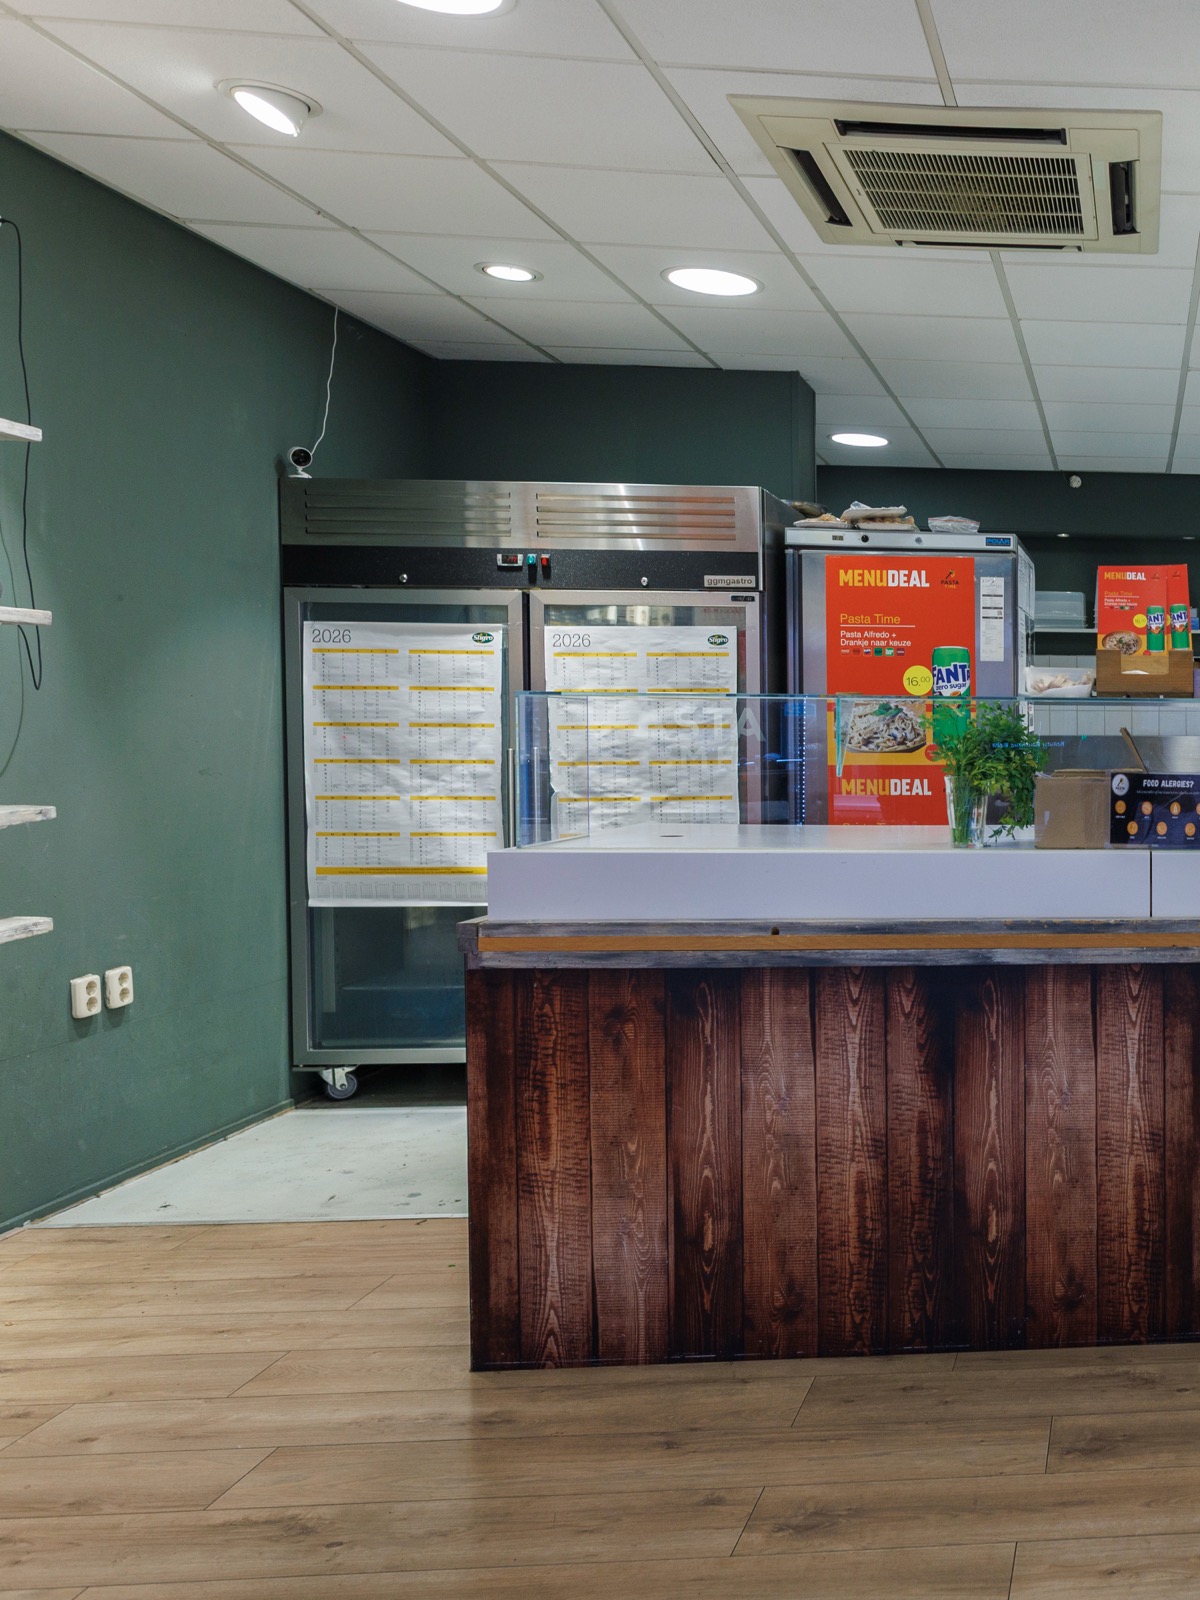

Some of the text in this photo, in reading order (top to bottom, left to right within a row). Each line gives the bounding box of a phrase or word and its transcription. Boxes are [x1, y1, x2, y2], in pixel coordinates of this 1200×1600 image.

[707, 576, 752, 586] ggmgastro
[839, 570, 930, 588] MENUDEAL
[1104, 572, 1146, 580] MENUDEAL
[840, 614, 900, 624] Pasta Time
[312, 629, 351, 643] 2026
[472, 634, 494, 643] Sligro
[552, 634, 591, 647] 2026
[708, 634, 728, 646] Sligro
[840, 639, 869, 647] Drankje
[841, 779, 932, 796] MENUDEAL
